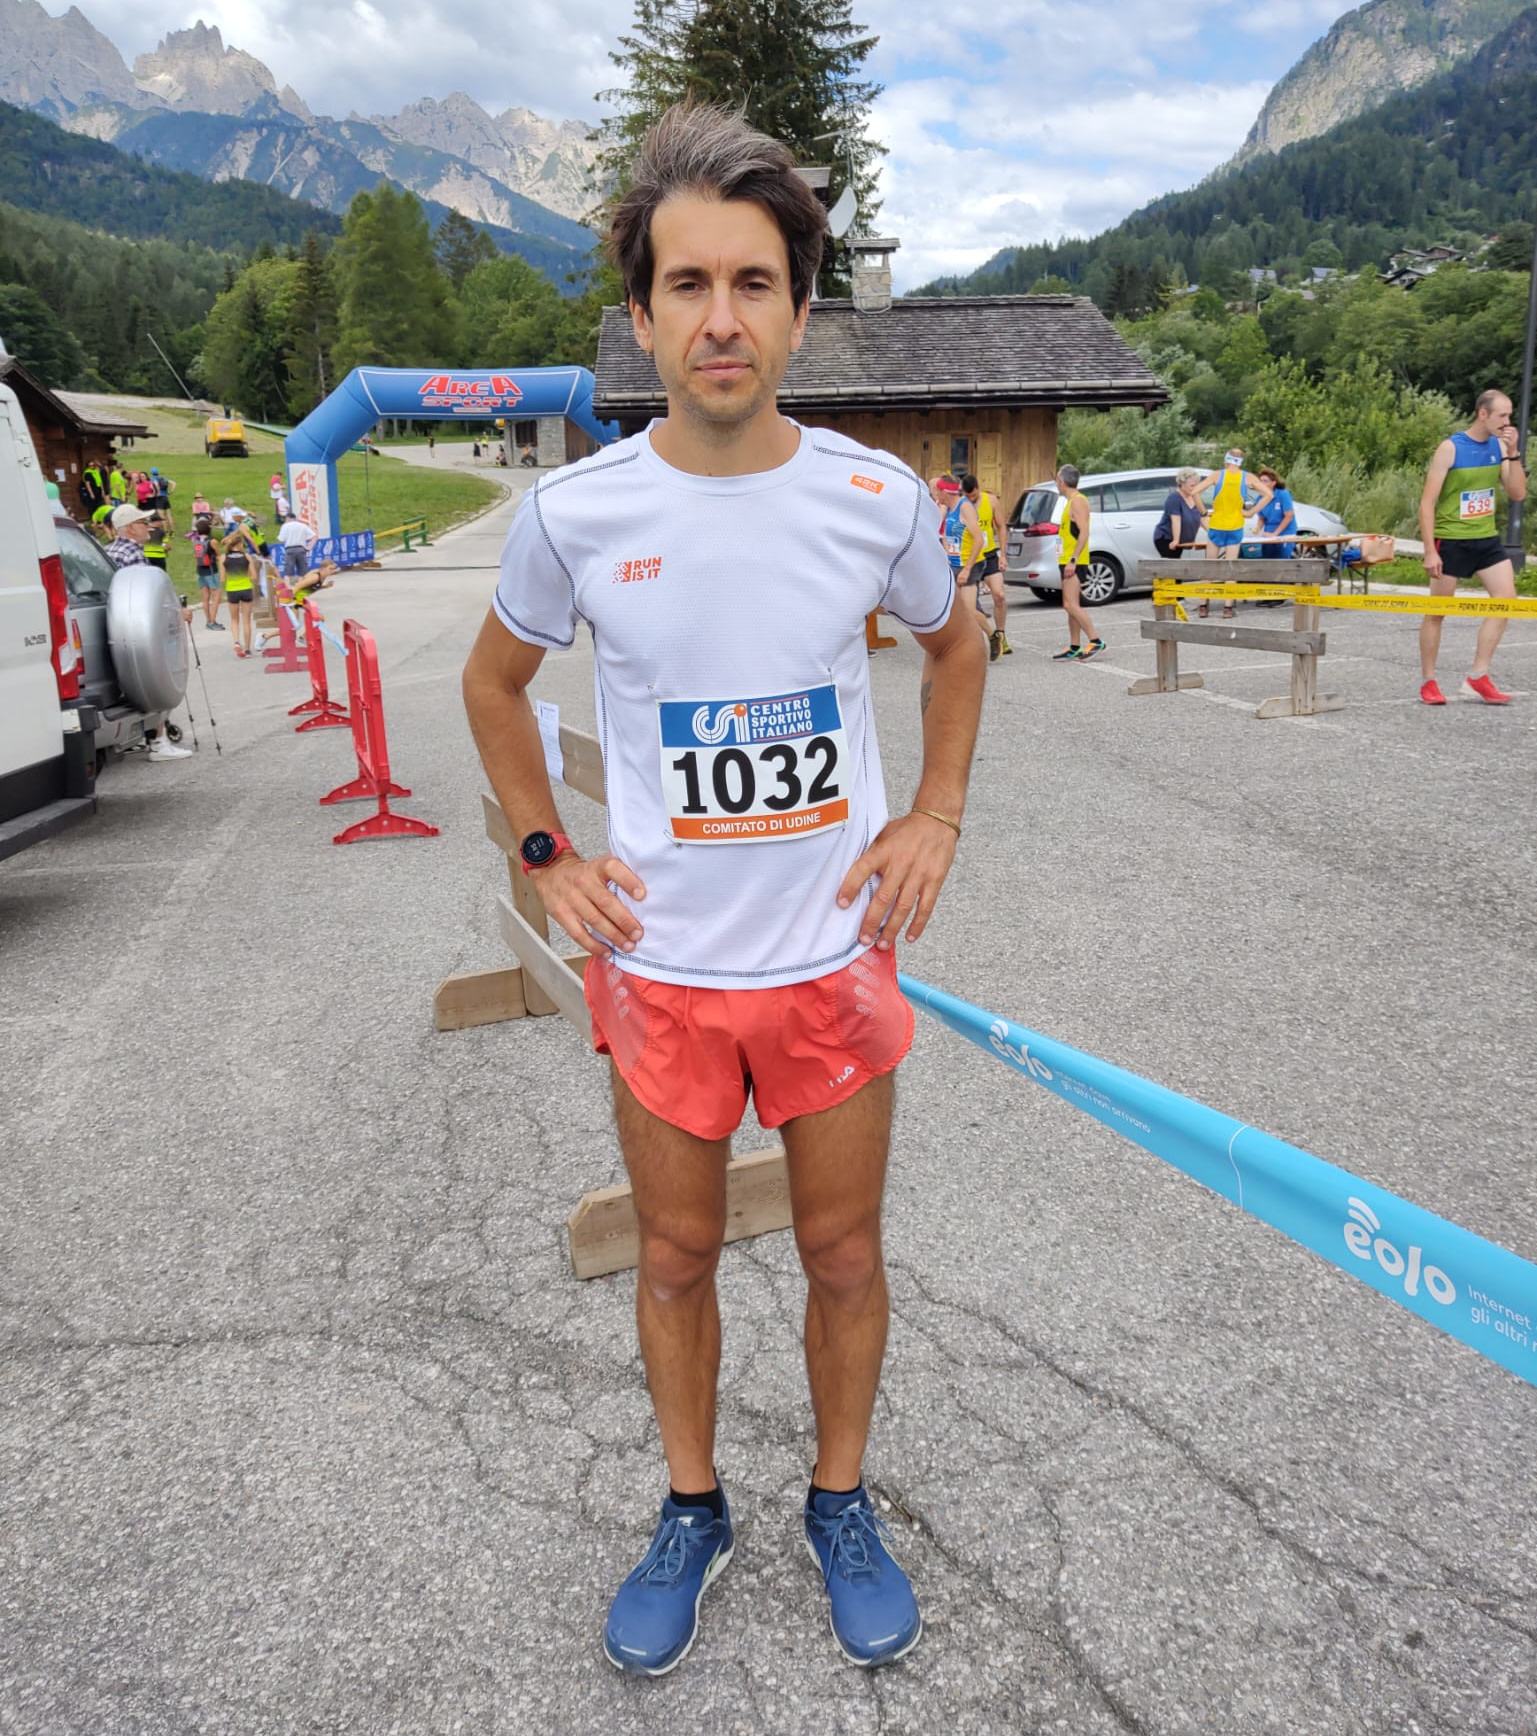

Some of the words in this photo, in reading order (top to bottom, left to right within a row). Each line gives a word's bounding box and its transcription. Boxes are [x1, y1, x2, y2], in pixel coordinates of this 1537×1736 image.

[422, 397, 523, 407] SPORT
[1467, 498, 1490, 513] 639
[634, 556, 662, 570] RUN
[632, 570, 644, 581] IS
[648, 567, 661, 579] IT
[1458, 602, 1479, 611] FORNI
[1489, 603, 1509, 612] SOPRA
[750, 697, 810, 716] CENTRO
[751, 709, 811, 728] SPORTIVO
[752, 720, 813, 738] ITALIANO
[673, 736, 839, 814] 1032
[702, 821, 766, 834] COMITATO
[770, 819, 782, 831] DI
[786, 812, 821, 829] UDINE
[989, 1034, 1053, 1081] eolo
[1111, 1106, 1151, 1134] arrivano
[1343, 1221, 1457, 1305] eolo
[1468, 1285, 1532, 1330] Internet
[1471, 1307, 1490, 1325] gli
[1494, 1318, 1528, 1347] altri
